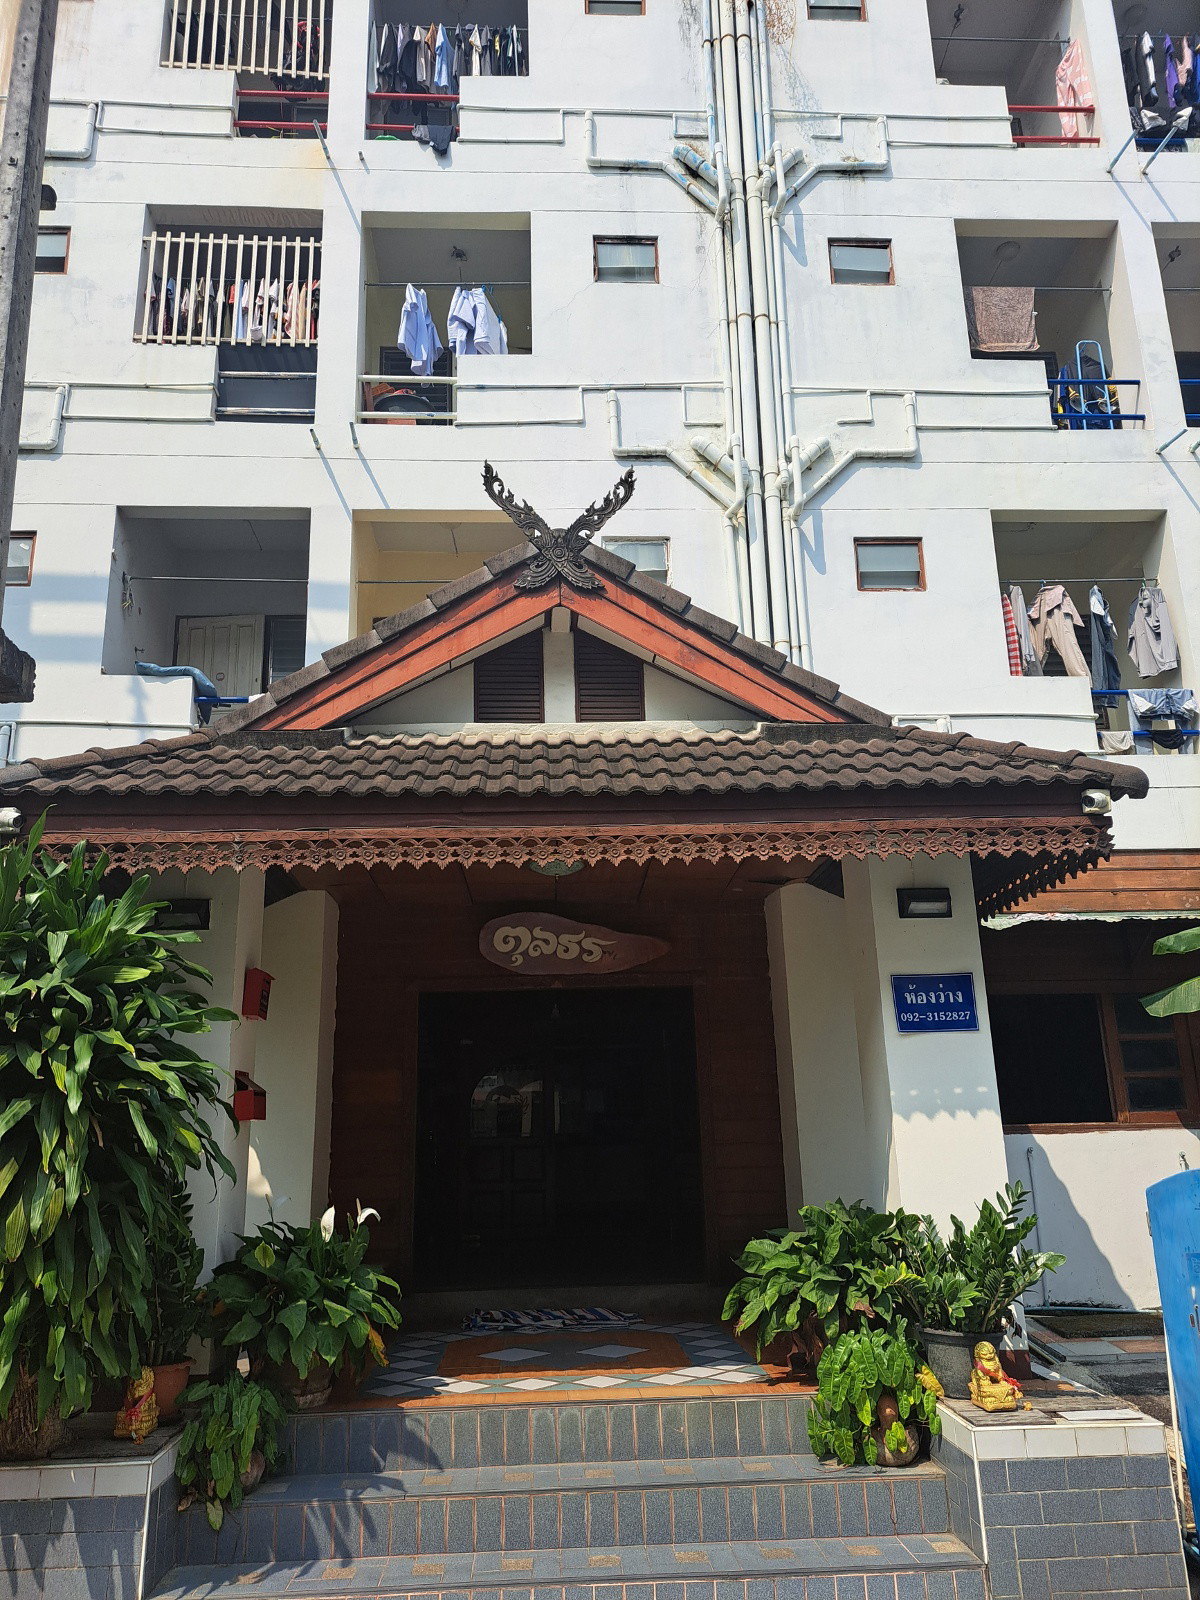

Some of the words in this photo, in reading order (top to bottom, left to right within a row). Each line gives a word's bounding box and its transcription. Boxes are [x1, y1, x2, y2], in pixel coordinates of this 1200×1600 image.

[904, 983, 963, 1004] ห้องว่าง
[900, 1011, 970, 1022] 092-3152827
